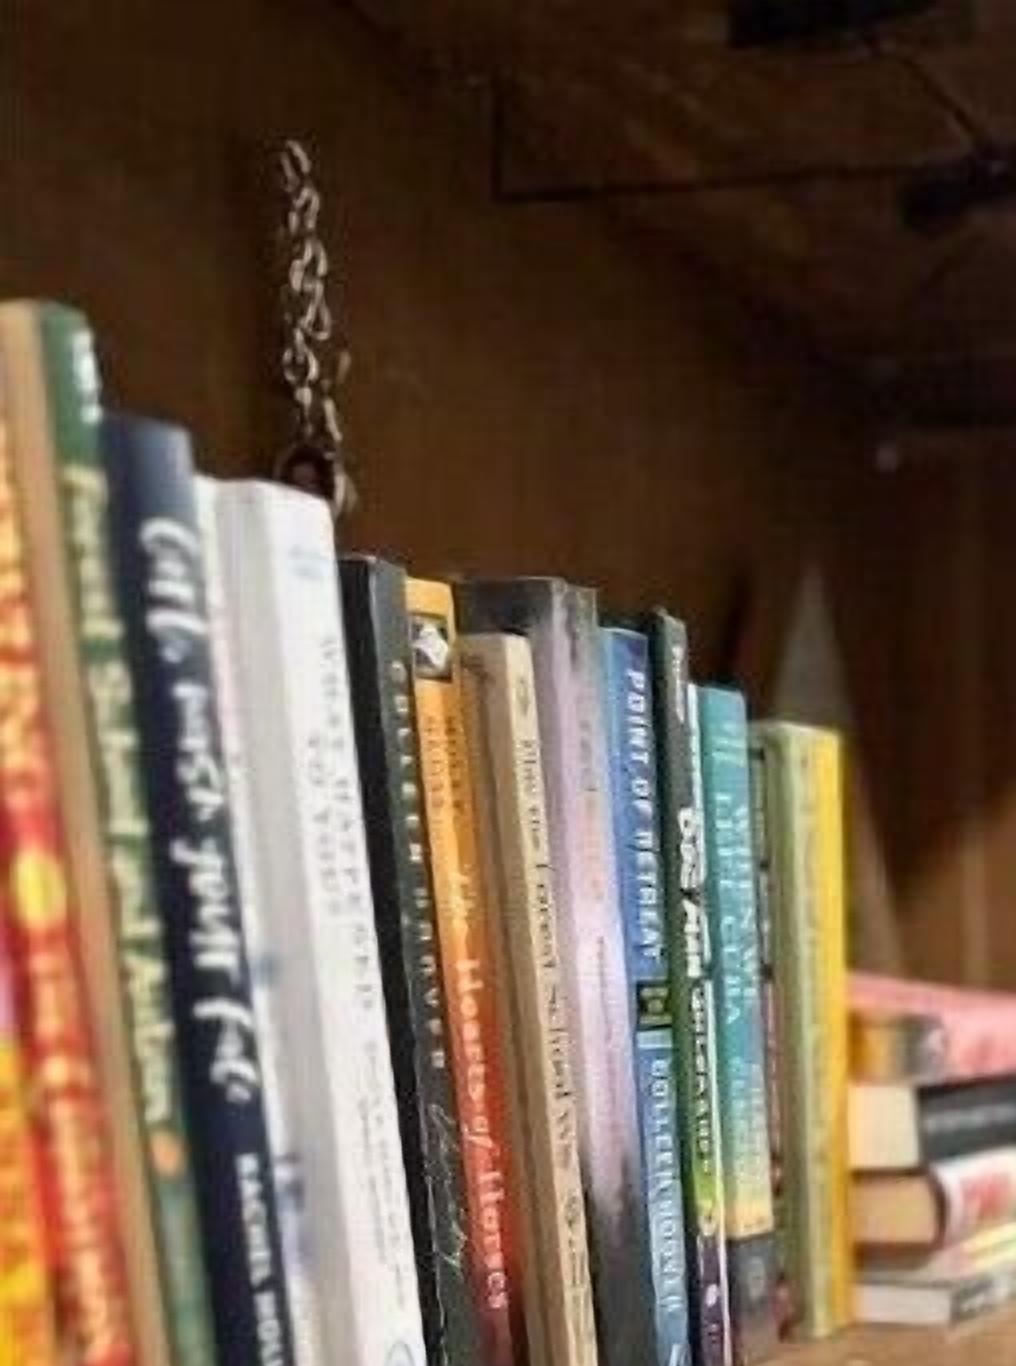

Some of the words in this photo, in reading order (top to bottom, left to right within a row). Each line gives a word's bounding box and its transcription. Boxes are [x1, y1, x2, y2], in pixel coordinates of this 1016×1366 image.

[623, 670, 650, 766] POINT
[389, 660, 424, 864] COLLEEN
[414, 885, 446, 1070] HOOVER
[631, 776, 652, 819] OF
[675, 807, 698, 889] DOG
[168, 835, 239, 988] your
[634, 828, 662, 963] RETREAT
[681, 897, 703, 979] MAN
[454, 957, 493, 1104] Hearts
[475, 1168, 513, 1311] Horses
[647, 1053, 676, 1194] COLLEEN
[234, 1149, 275, 1285] RACHEL
